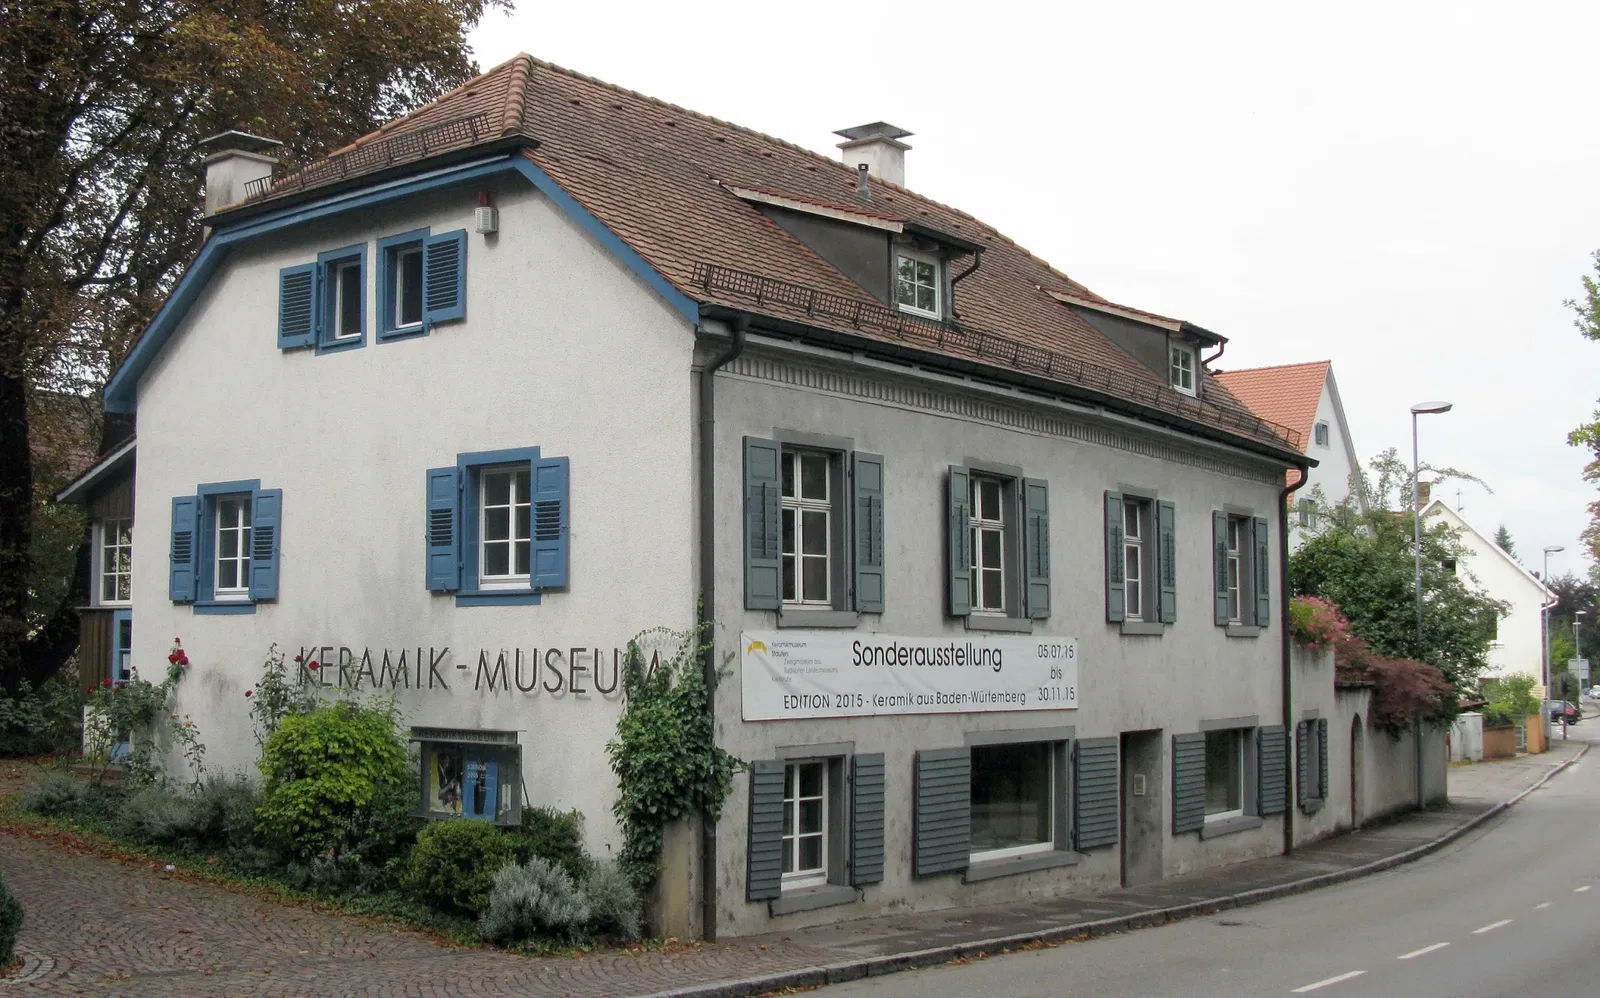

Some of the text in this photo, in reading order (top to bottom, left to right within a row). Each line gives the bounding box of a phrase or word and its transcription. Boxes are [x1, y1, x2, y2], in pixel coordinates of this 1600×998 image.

[853, 641, 1002, 672] Sonderausstellung
[1038, 644, 1074, 659] 05.07.15
[1050, 666, 1063, 679] bis
[784, 694, 830, 709] EDITION
[835, 693, 863, 709] 2015
[873, 693, 914, 707] Keramik
[916, 693, 934, 705] aus
[936, 689, 1026, 706] Baden-Würtemberg
[1038, 687, 1075, 701] 30.11.15
